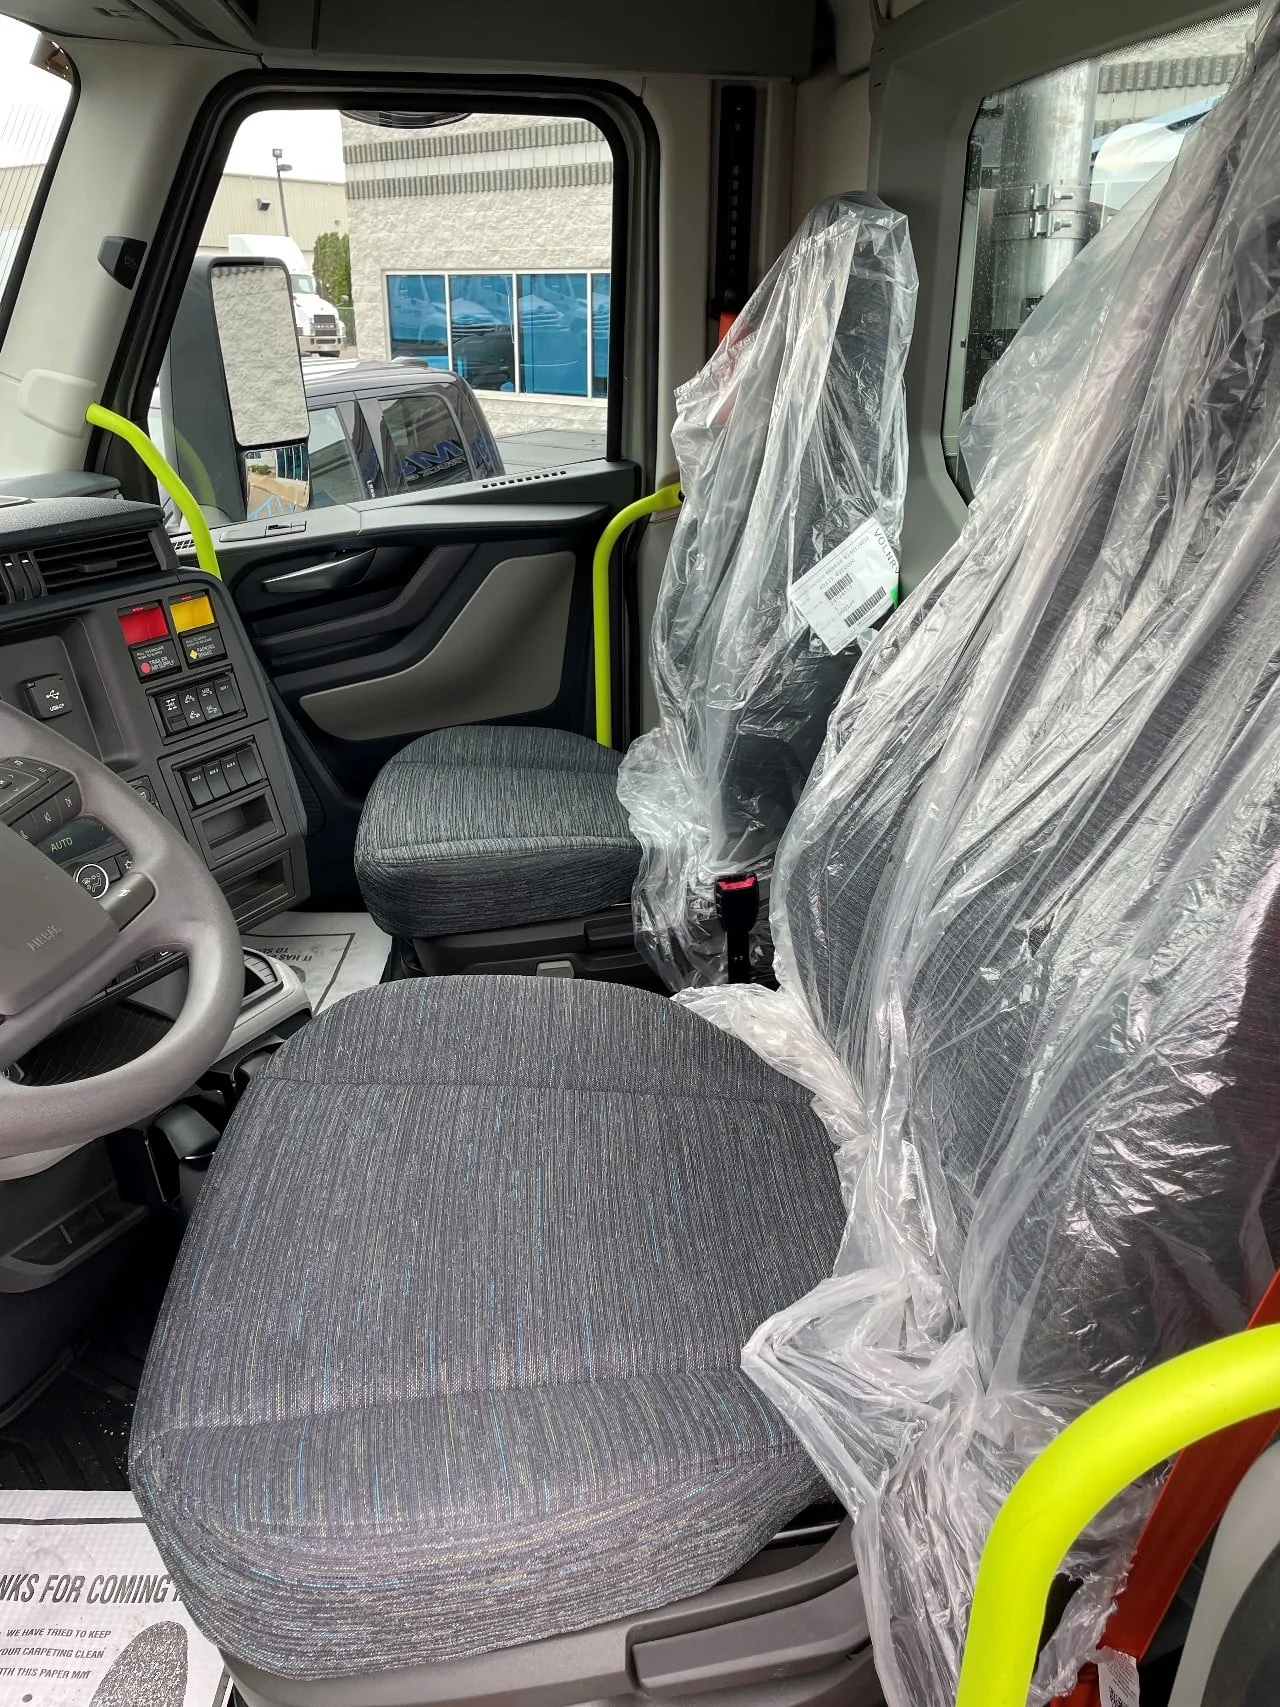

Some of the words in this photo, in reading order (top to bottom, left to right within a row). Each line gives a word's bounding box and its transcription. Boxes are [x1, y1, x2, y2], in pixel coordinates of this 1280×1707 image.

[51, 837, 73, 853] AUTO
[39, 1574, 86, 1603] FOR
[87, 1574, 171, 1604] COMING
[7, 1629, 21, 1637] WE
[22, 1628, 45, 1637] HAVE
[47, 1628, 73, 1637] TRIED
[76, 1629, 87, 1638] TO
[88, 1630, 112, 1638] KEEP
[22, 1647, 73, 1658] CARPETING
[75, 1650, 105, 1659] CLEAN
[17, 1667, 38, 1676] THIS
[39, 1668, 70, 1679] PAPER
[71, 1670, 92, 1680] MAT
